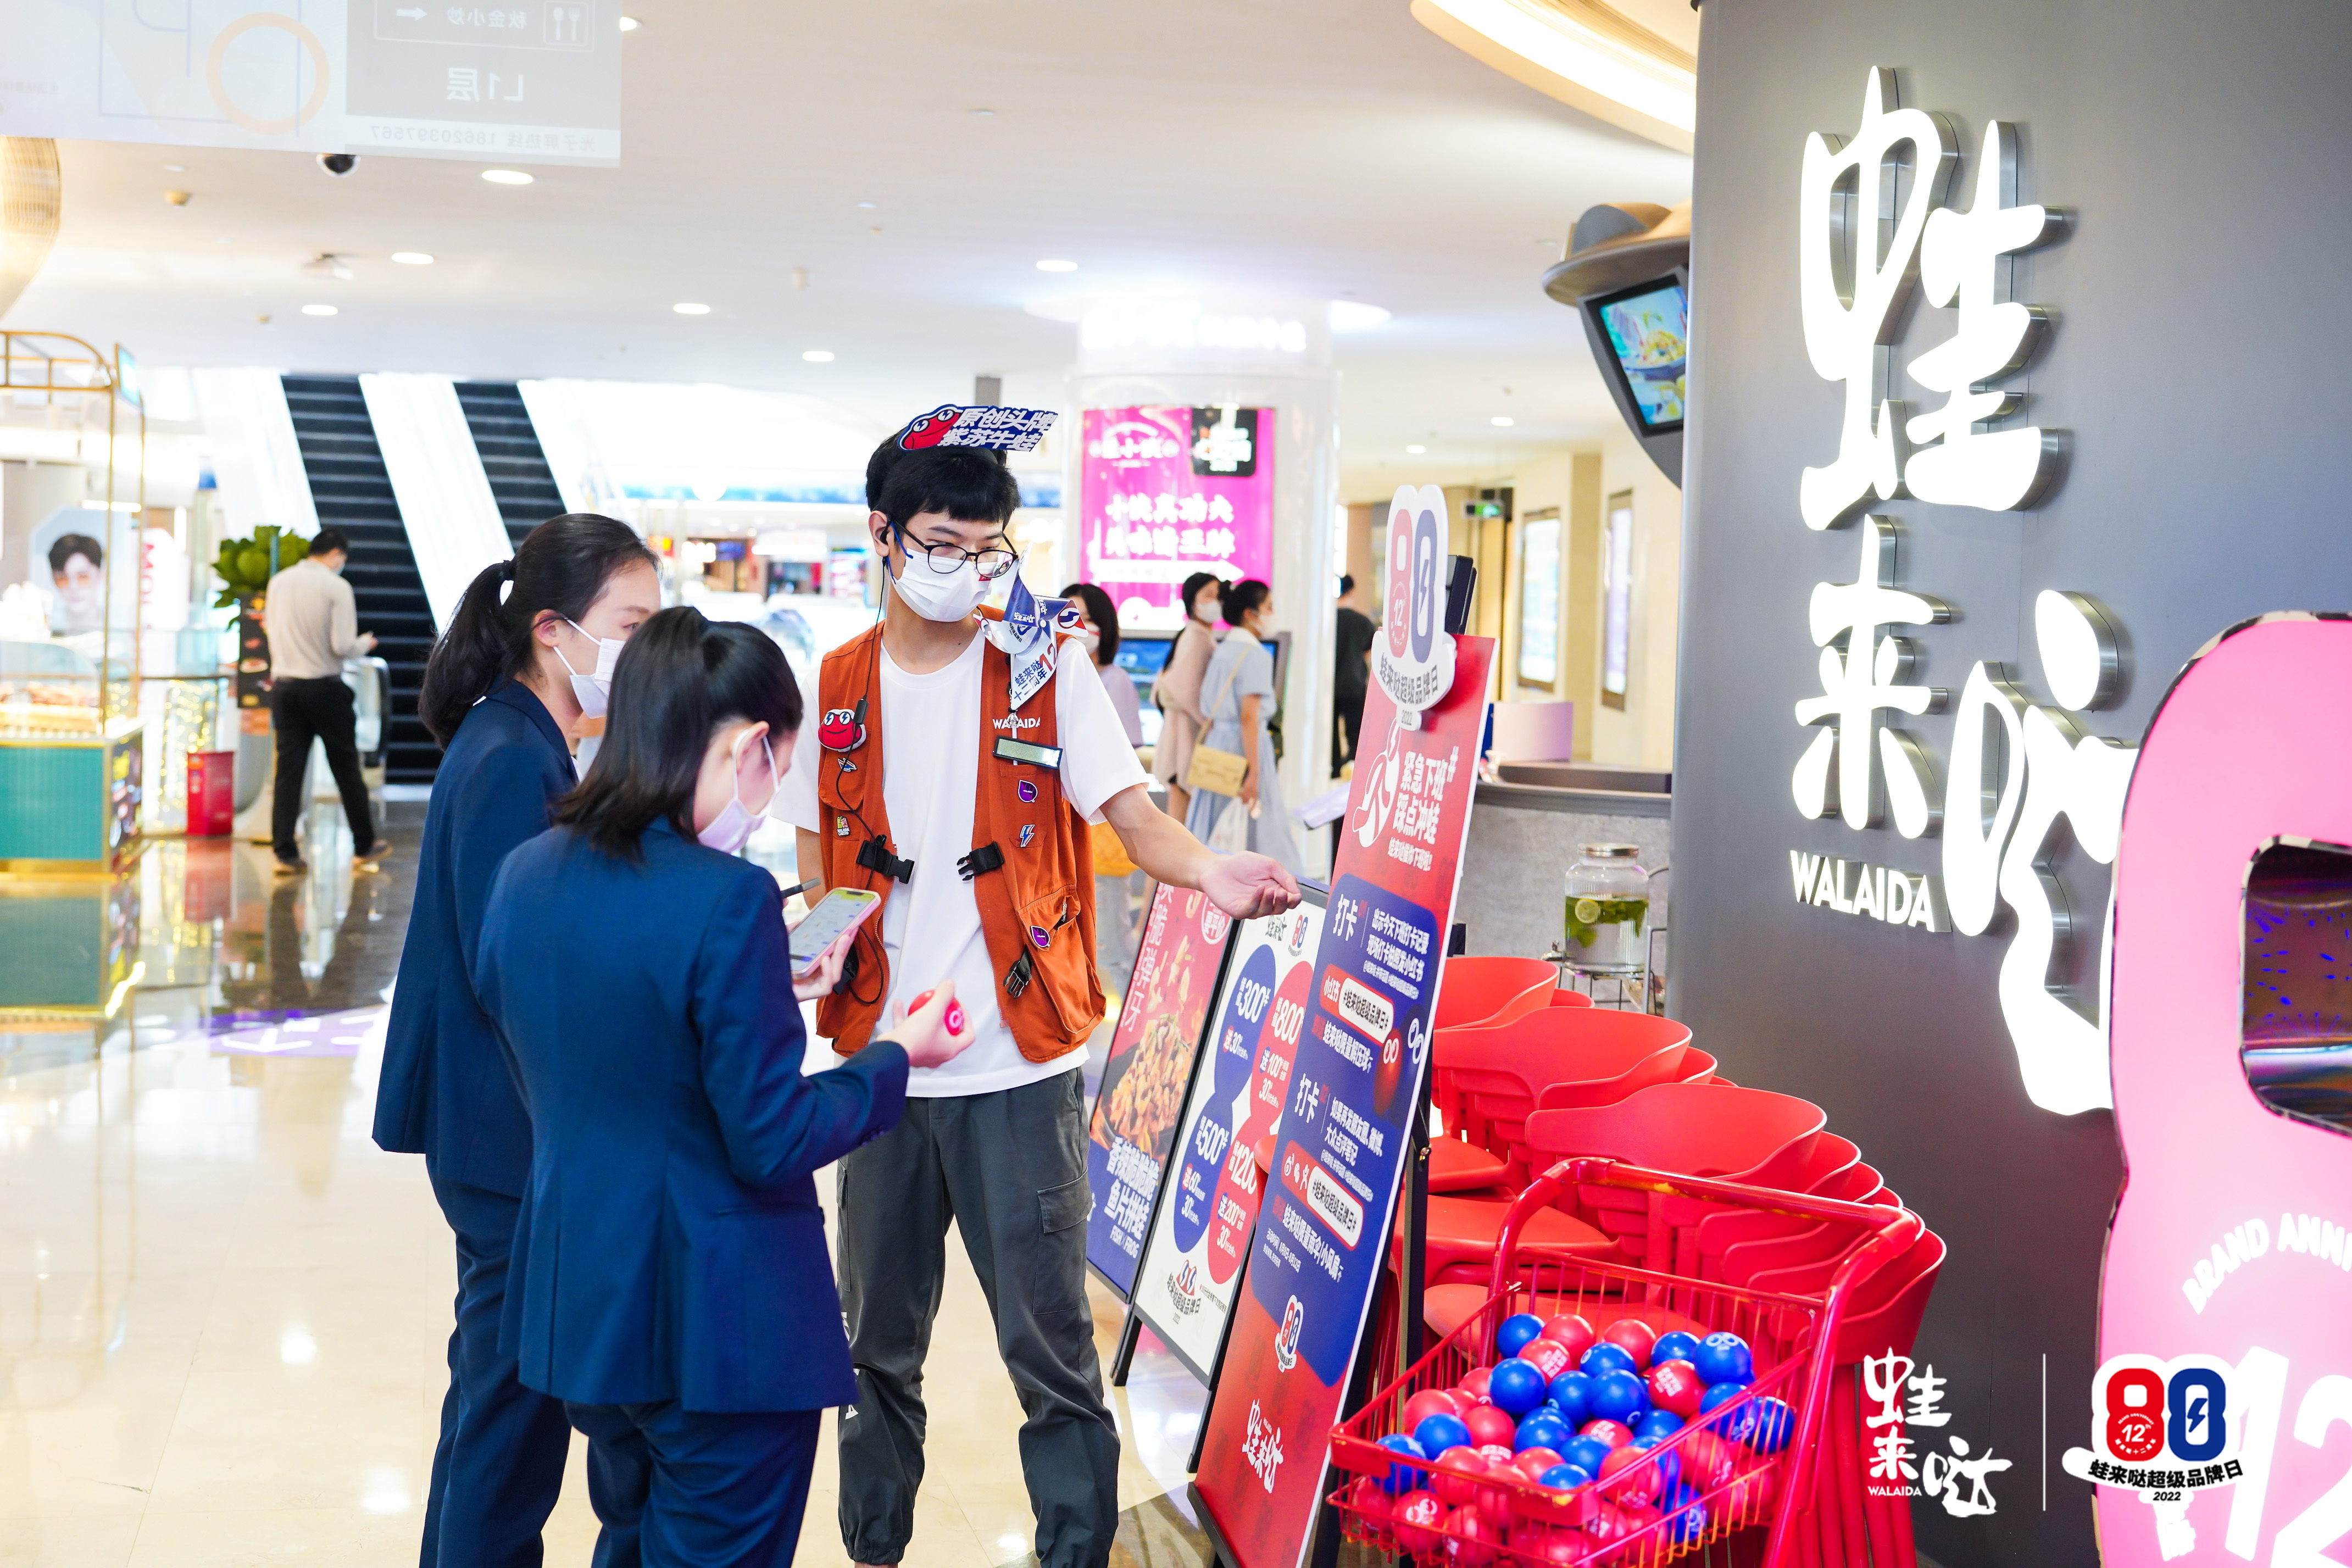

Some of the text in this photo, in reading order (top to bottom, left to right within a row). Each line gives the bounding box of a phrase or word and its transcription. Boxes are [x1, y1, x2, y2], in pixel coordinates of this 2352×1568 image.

[953, 408, 1058, 432] 原创头牌
[937, 428, 1043, 452] 紫苏牛蛙
[1014, 659, 1043, 687] 蛙来哒
[1014, 669, 1047, 701] 十二周年
[1380, 652, 1438, 705] 蛙来哒超级品牌日
[992, 717, 1041, 730] WAAIDA
[1402, 709, 1413, 726] 2022
[1392, 792, 1440, 845] 踩点冲蛙
[1790, 850, 1935, 932] WALAIDA
[1333, 894, 1358, 941] 打卡
[1324, 975, 1341, 1003] 小红书
[1274, 999, 1304, 1045] 800
[1260, 1049, 1270, 1071] 送
[1294, 1073, 1320, 1124] 打卡
[1325, 1122, 1359, 1166] 大众点评笔记
[1104, 1178, 1150, 1241] 鱼片拼蛙
[1218, 1194, 1228, 1217] 送
[1110, 1224, 1122, 1245] FISH
[1123, 1235, 1139, 1259] FROG
[2182, 1218, 2270, 1315] BRAND
[1242, 1398, 1283, 1494] 蛙来哒
